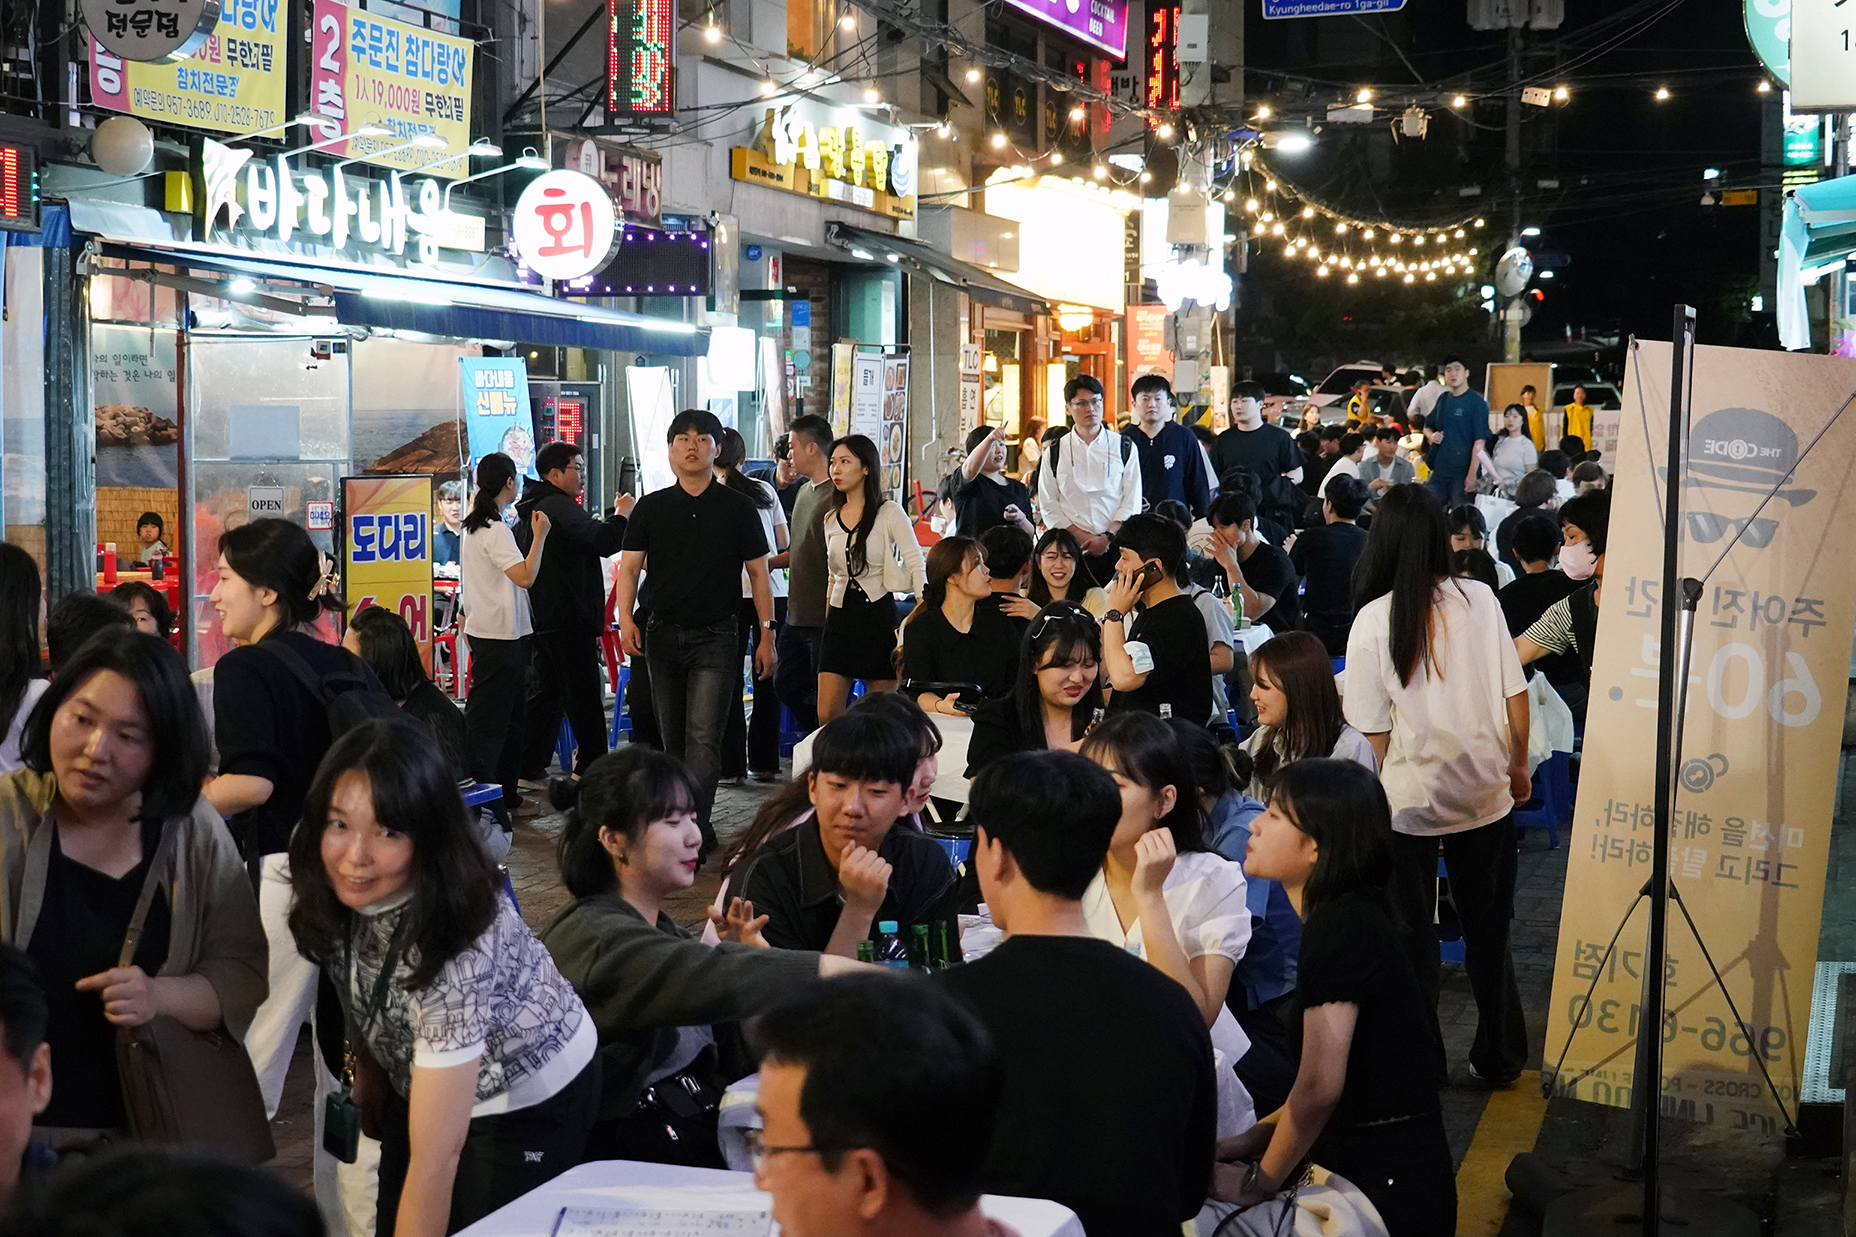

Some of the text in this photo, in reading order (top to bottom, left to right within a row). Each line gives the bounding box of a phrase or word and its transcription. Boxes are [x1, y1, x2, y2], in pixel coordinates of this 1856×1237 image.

[1269, 3, 1351, 16] Kyungheedae-ro
[105, 10, 180, 38] 전문점
[1089, 17, 1104, 37] BEER
[351, 18, 400, 73] 주문진
[177, 66, 240, 98] 참치전문점
[133, 87, 165, 113] 예약문의
[372, 79, 421, 115] 19,000원
[247, 152, 447, 266] 바다내음
[534, 187, 594, 259] 회
[112, 354, 148, 366] 일이라면
[964, 350, 979, 370] TLC
[477, 391, 517, 416] 신메뉴
[251, 499, 282, 511] OPEN
[352, 513, 427, 562] 도다리
